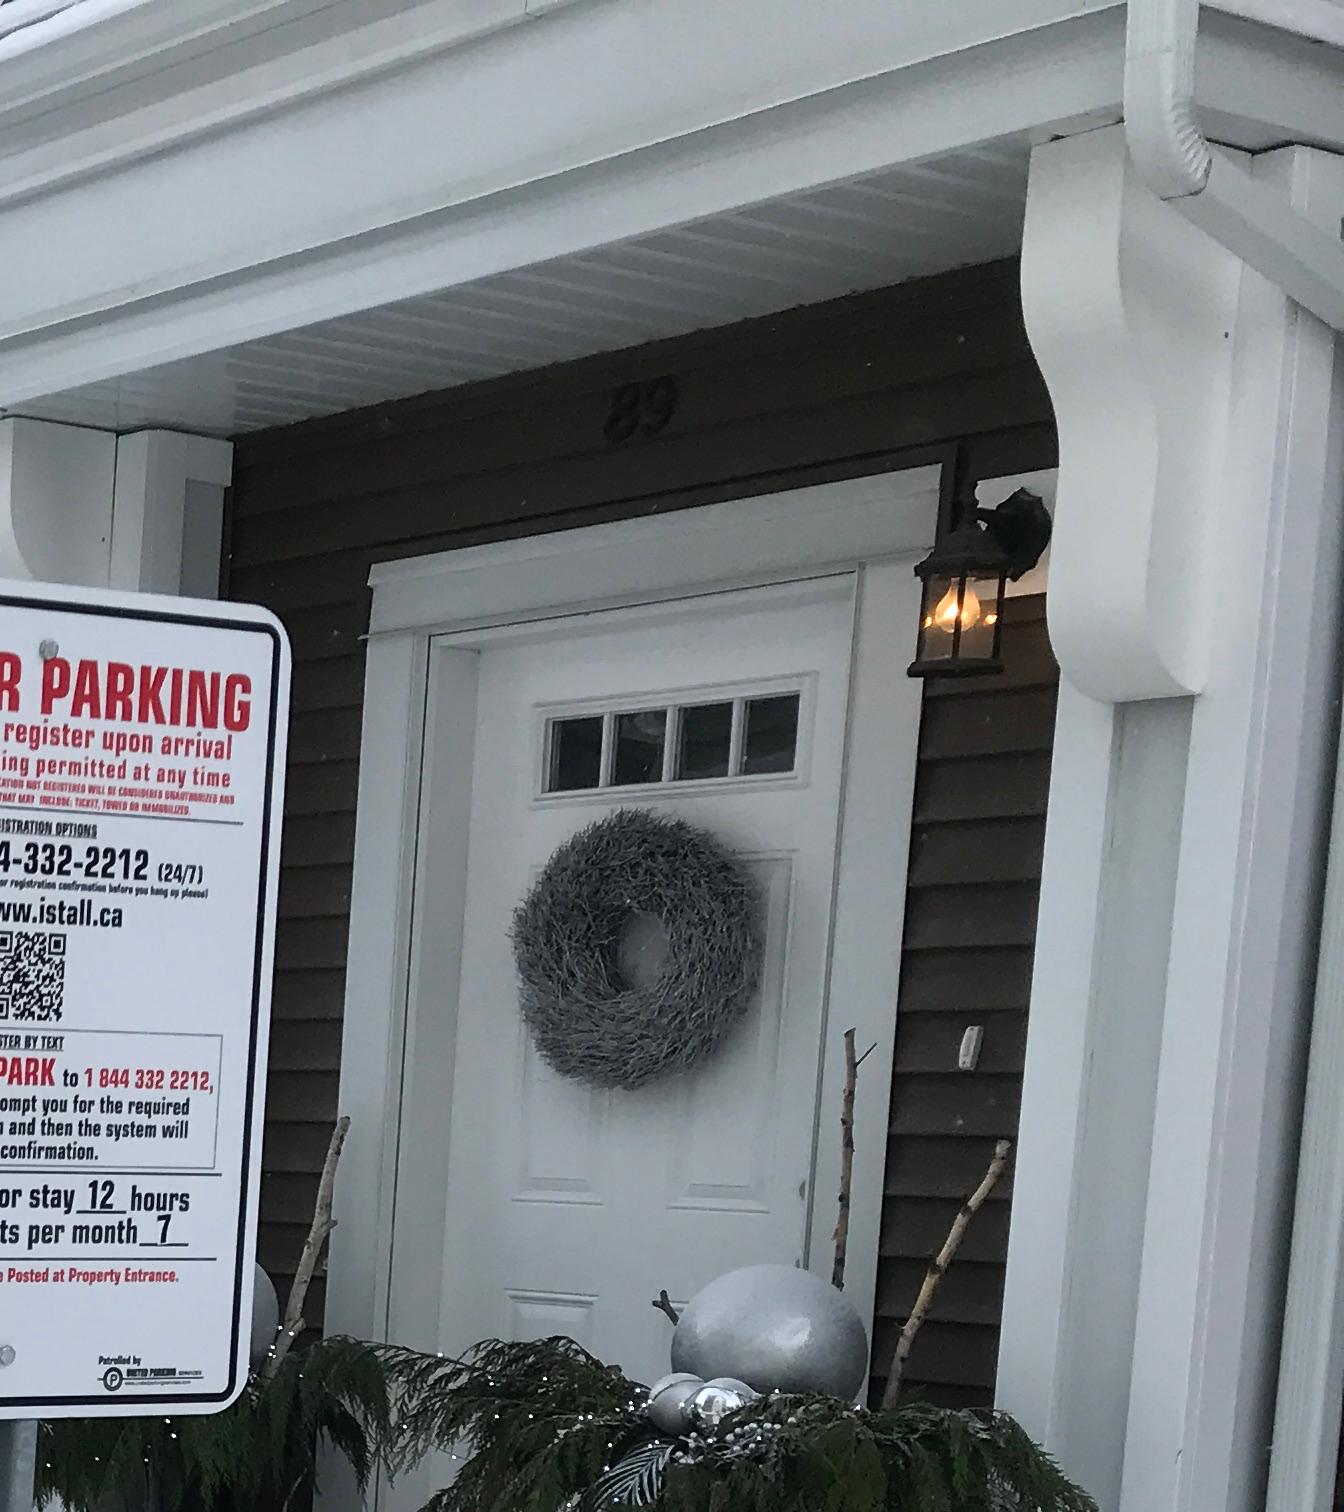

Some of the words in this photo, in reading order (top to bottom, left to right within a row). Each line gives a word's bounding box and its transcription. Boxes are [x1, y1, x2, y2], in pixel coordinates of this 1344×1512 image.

[603, 374, 678, 443] 89
[40, 656, 252, 732] PARKING
[3, 718, 95, 751] register
[102, 731, 153, 757] upon
[160, 731, 232, 760] arrival
[35, 755, 127, 779] permitted
[132, 762, 151, 782] at
[156, 767, 186, 789] any
[192, 765, 230, 788] time
[55, 821, 98, 838] OPTIONS
[157, 862, 203, 885] (24/7)
[23, 1035, 38, 1050] BY
[40, 1036, 64, 1051] TEXT
[62, 1068, 78, 1087] to
[83, 1067, 93, 1088] 1
[99, 1067, 129, 1088] 844
[134, 1068, 165, 1089] 332
[169, 1070, 213, 1094] 2212,
[41, 1098, 68, 1116] you
[72, 1093, 95, 1114] for
[99, 1094, 123, 1114] the
[127, 1096, 190, 1118] required
[8, 1115, 36, 1136] and
[40, 1116, 73, 1136] then
[77, 1117, 101, 1137] the
[105, 1118, 157, 1140] system
[161, 1119, 188, 1139] will
[0, 1140, 99, 1160] confirmation.
[28, 1183, 76, 1215] stay
[88, 1179, 114, 1210] 12
[130, 1184, 190, 1214] hours
[26, 1224, 65, 1250] per
[71, 1216, 137, 1244] month
[156, 1213, 172, 1243] 7
[7, 1266, 49, 1283] Posted
[52, 1268, 65, 1282] at
[68, 1267, 121, 1285] Property
[124, 1266, 178, 1282] Entrance.
